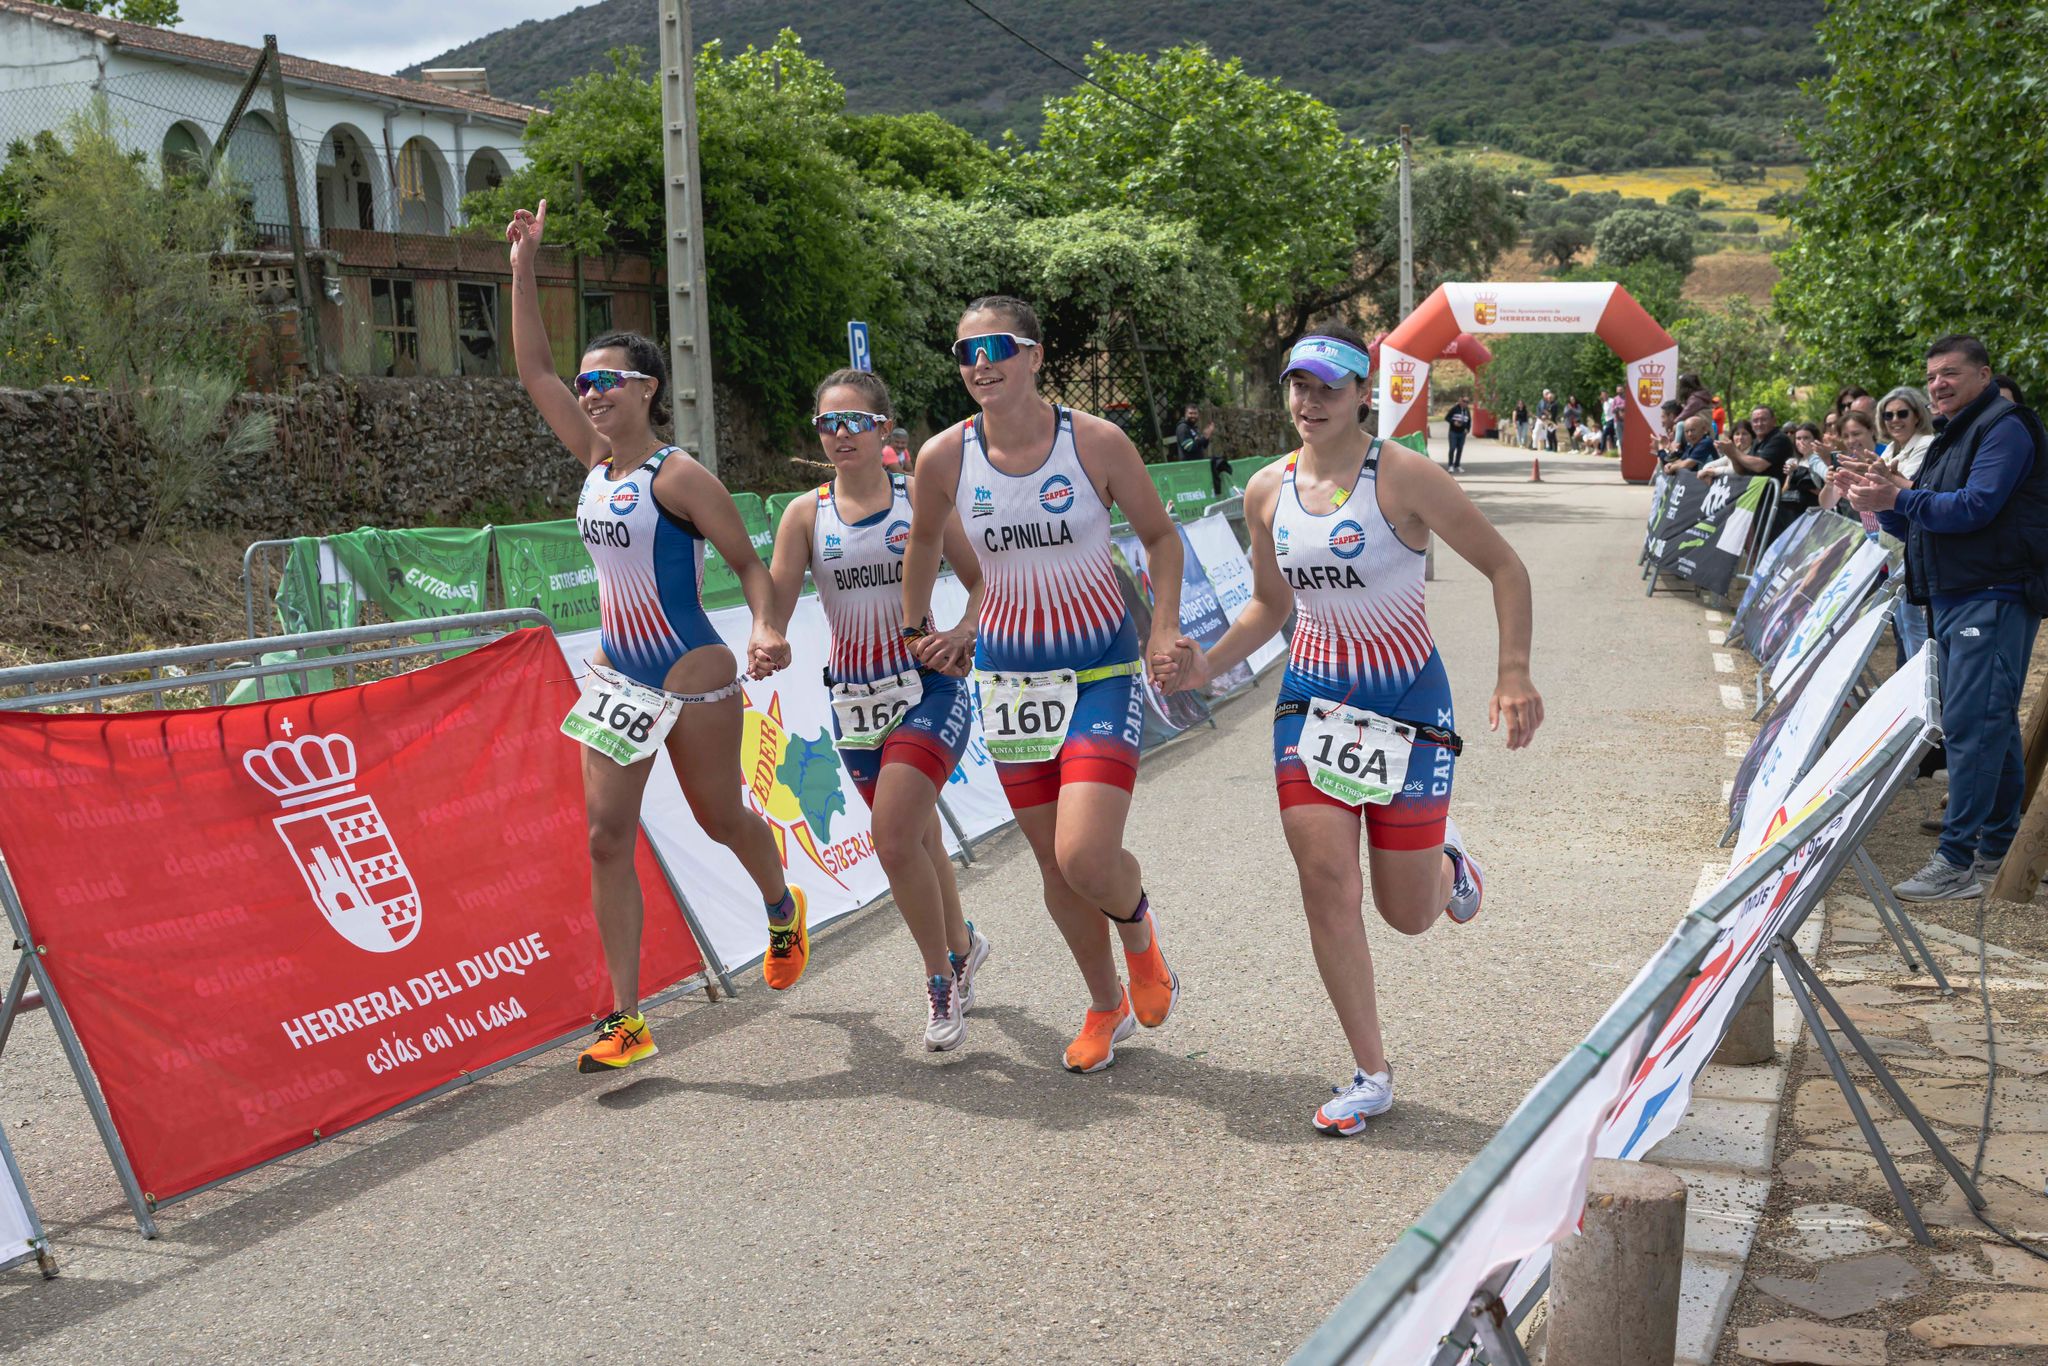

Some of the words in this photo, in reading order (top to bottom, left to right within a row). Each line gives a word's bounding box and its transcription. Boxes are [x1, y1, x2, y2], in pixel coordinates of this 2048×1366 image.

[1554, 315, 1580, 323] DUQUE
[854, 329, 866, 370] P
[613, 493, 634, 502] CAPEX
[1044, 488, 1069, 501] CAPEX
[890, 532, 911, 543] CAPE
[984, 519, 1073, 552] C.PINILLA
[1333, 534, 1359, 545] CAPEX
[1283, 565, 1366, 589] ZAFRA
[588, 692, 655, 743] 16B
[939, 680, 970, 749] CAPEX
[995, 700, 1066, 736] 16D
[1122, 675, 1144, 747] CAPEX
[748, 719, 778, 817] CEDER
[1312, 734, 1388, 785] 16A
[1431, 707, 1452, 797] CAPX
[417, 773, 543, 827] recompensa
[1323, 777, 1334, 787] DE
[54, 797, 164, 831] voluntad
[502, 803, 581, 847] deporte
[163, 842, 261, 878] deporte
[55, 872, 128, 906] salud
[453, 868, 543, 911] impulso
[103, 903, 250, 948] recompensa
[194, 956, 293, 998] esfuerzo
[281, 985, 409, 1050] HERRERA
[407, 968, 462, 1007] DEL
[456, 931, 551, 988] DUQUE
[366, 1030, 422, 1075] estás
[422, 1025, 454, 1054] en
[446, 1012, 478, 1042] tu
[477, 996, 528, 1032] casa
